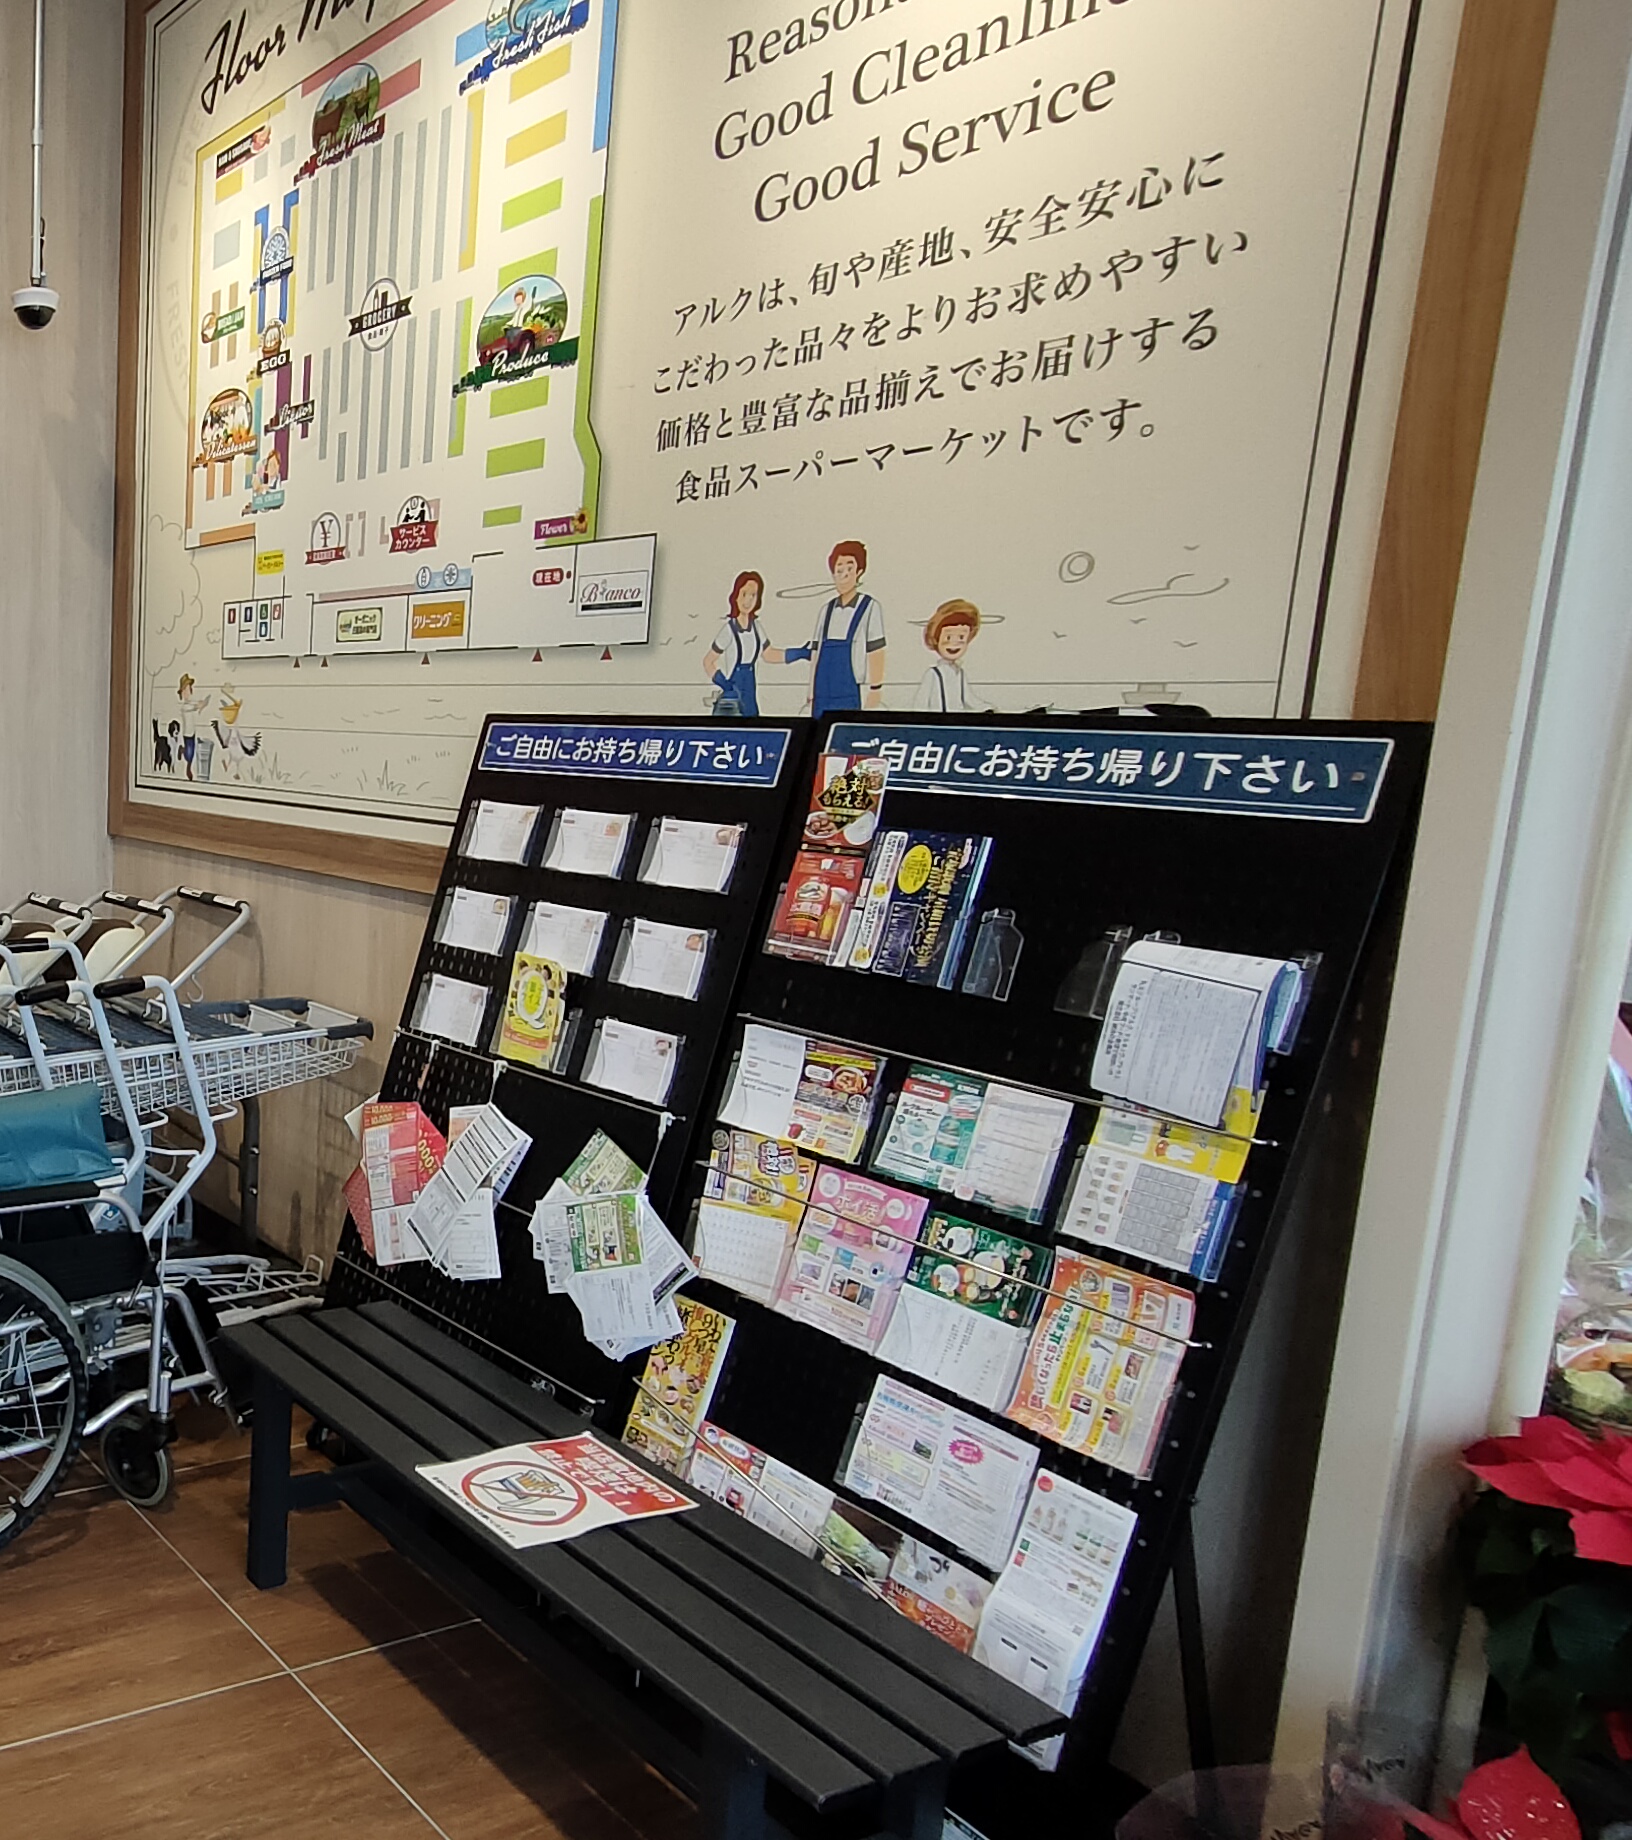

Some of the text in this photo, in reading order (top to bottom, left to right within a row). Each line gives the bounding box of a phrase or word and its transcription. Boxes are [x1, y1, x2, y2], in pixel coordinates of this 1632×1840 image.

[492, 0, 573, 68] Fresh Fish
[201, 9, 286, 115] Floor
[714, 71, 833, 161] Good
[317, 119, 379, 165] Fresh Meat
[754, 69, 1117, 223] Good Service
[673, 151, 1225, 336] アルクは、旬や産地、安全安心に
[362, 303, 397, 329] GROCERY
[653, 230, 1248, 397] こだわった品々をよりお求めやすい
[260, 355, 287, 371] EGG
[491, 342, 549, 377] Produce
[655, 309, 1219, 454] 価格と豊富な品揃えでお届けする
[675, 396, 1156, 505] 食品スーパーマーケットです。
[395, 537, 430, 550] カウンター
[399, 524, 426, 537] サービス
[535, 570, 561, 584] 現在地
[414, 611, 453, 628] クリーニング
[496, 734, 763, 769] ご自由にお持ち帰り下さい
[829, 775, 868, 795] 絶対
